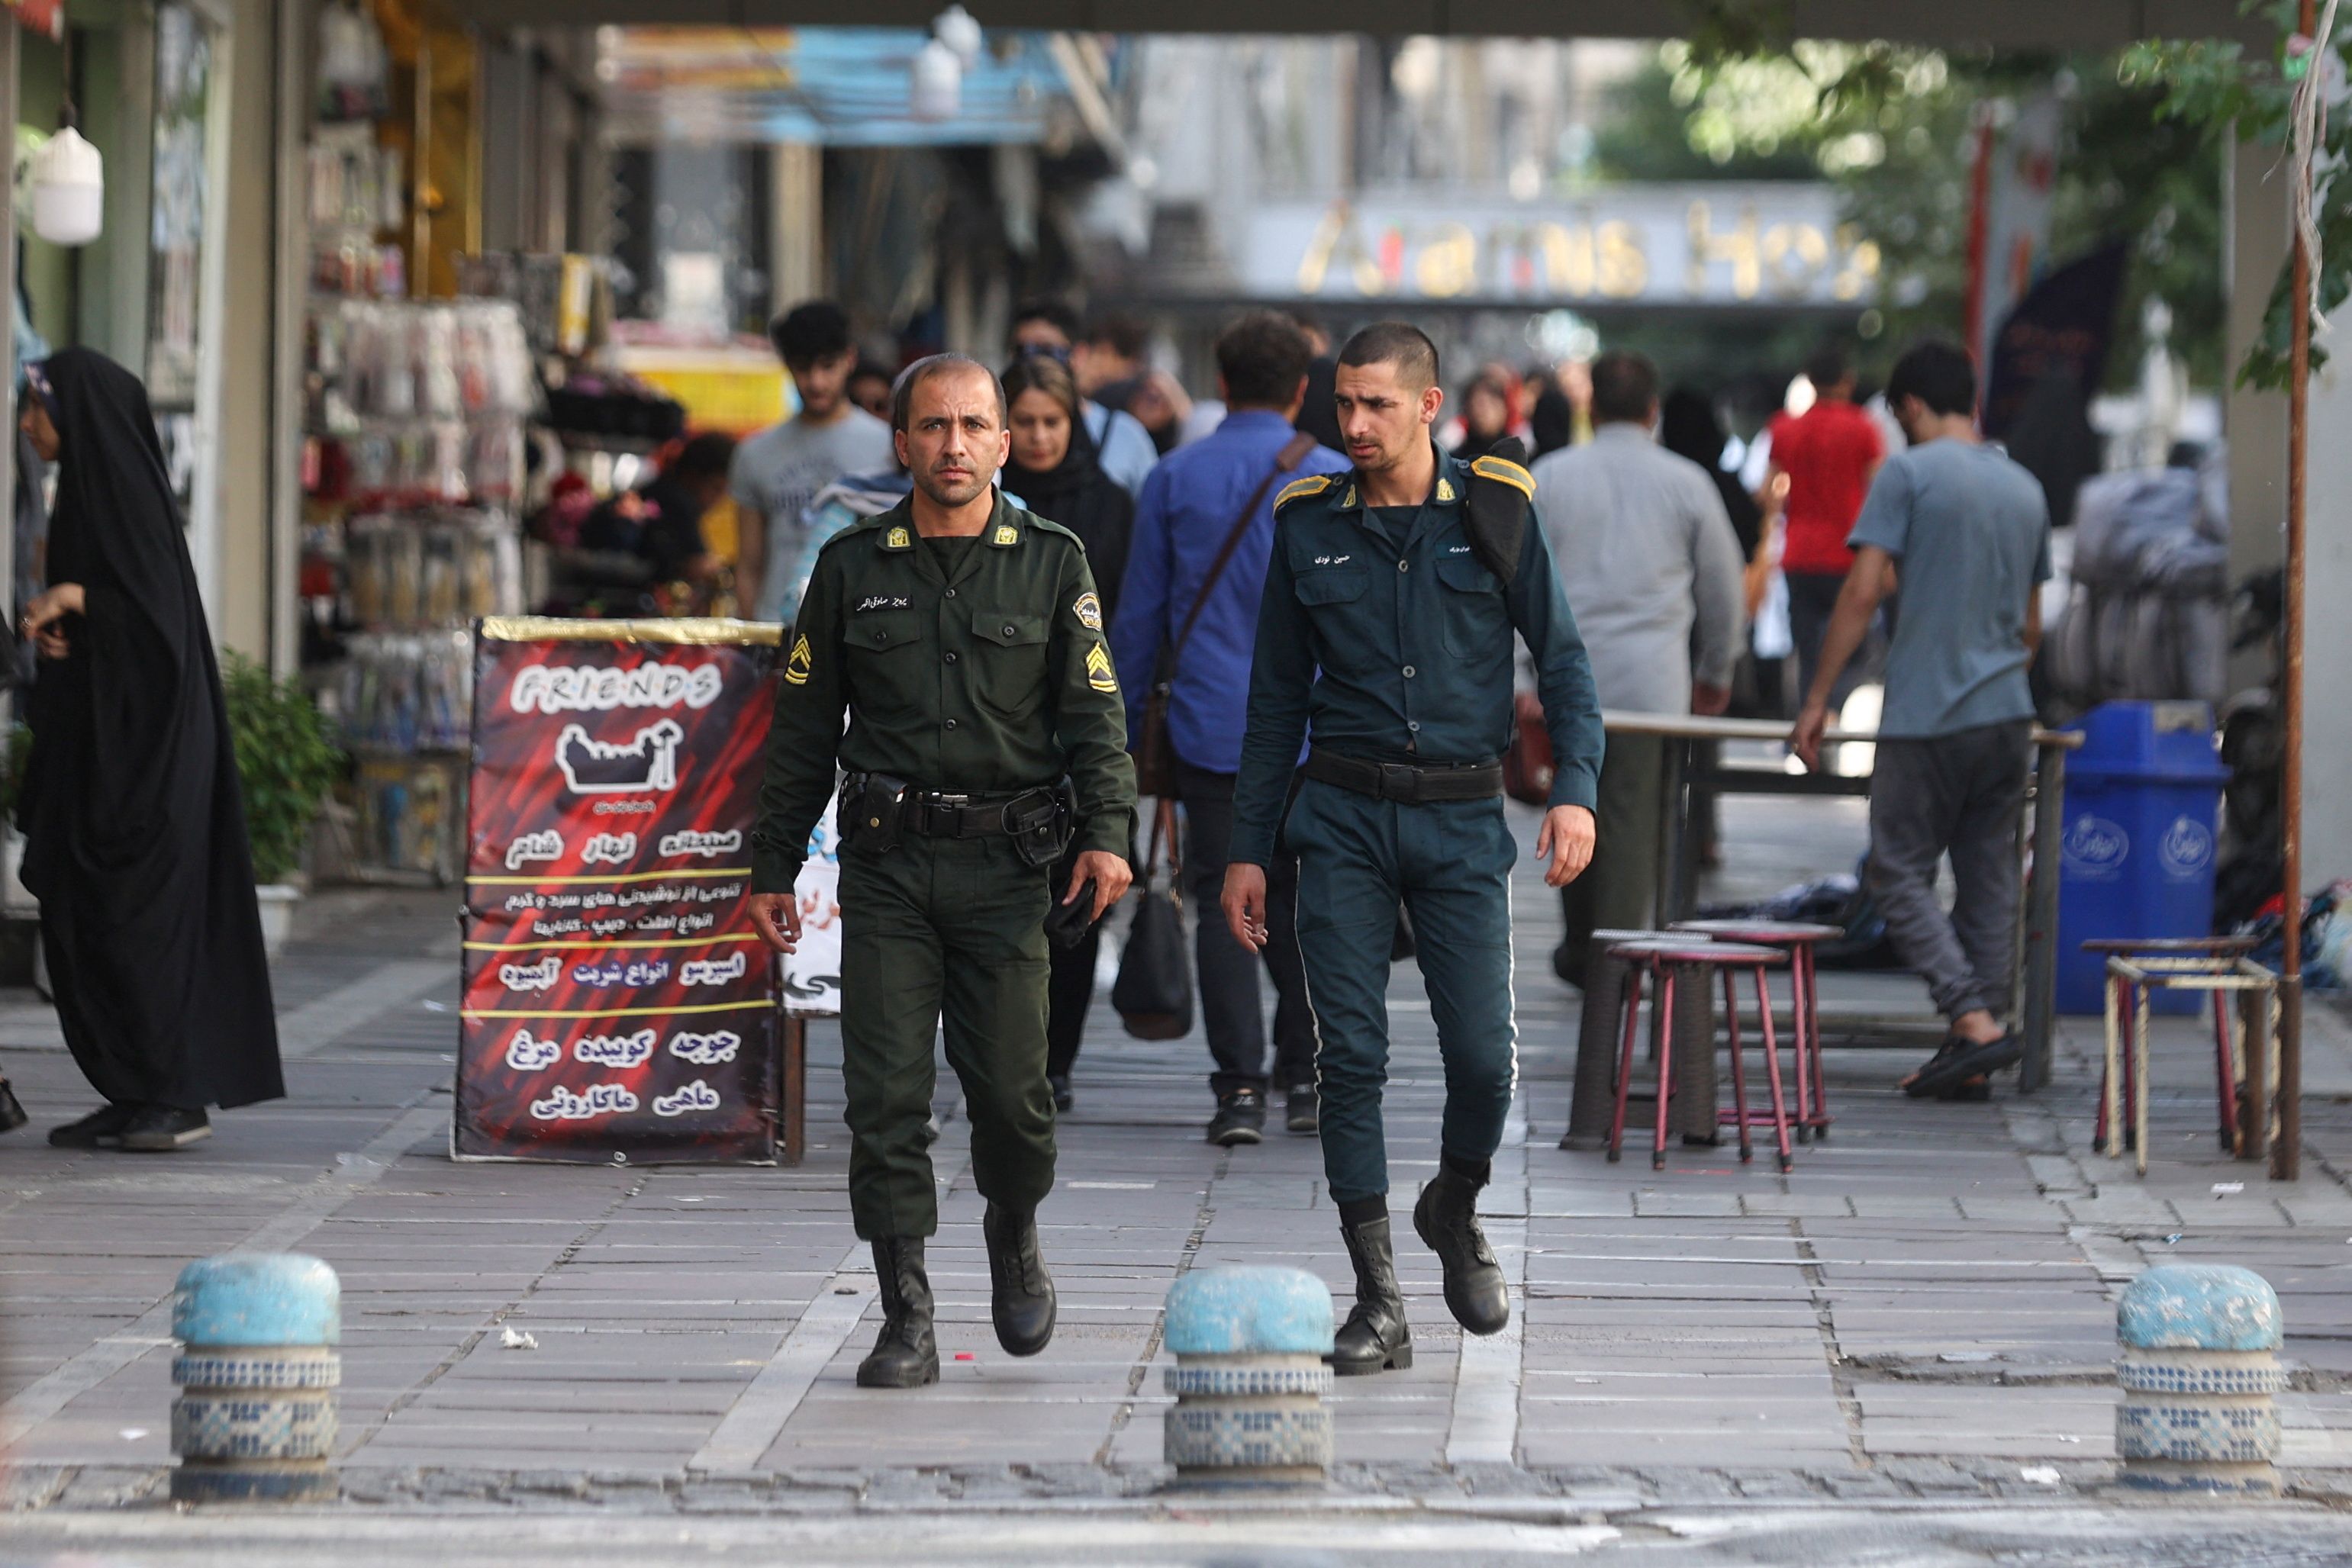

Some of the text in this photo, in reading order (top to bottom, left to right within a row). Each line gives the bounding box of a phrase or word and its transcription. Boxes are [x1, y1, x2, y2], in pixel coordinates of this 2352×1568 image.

[1314, 555, 1351, 565] حسین نوری
[514, 664, 719, 710] FRIENDS
[508, 832, 562, 868] شام
[661, 831, 739, 856] صبحانه
[505, 882, 742, 912] تنوعی از نوشیدنی های سرد و گرم
[678, 912, 714, 935] انواع
[501, 958, 561, 989] آبمیوه
[573, 963, 623, 987] شربت
[623, 961, 669, 987] انواع
[508, 1030, 739, 1068] جوجه کوبیده مرغ
[533, 1080, 718, 1117] ماهی ماکارونی
